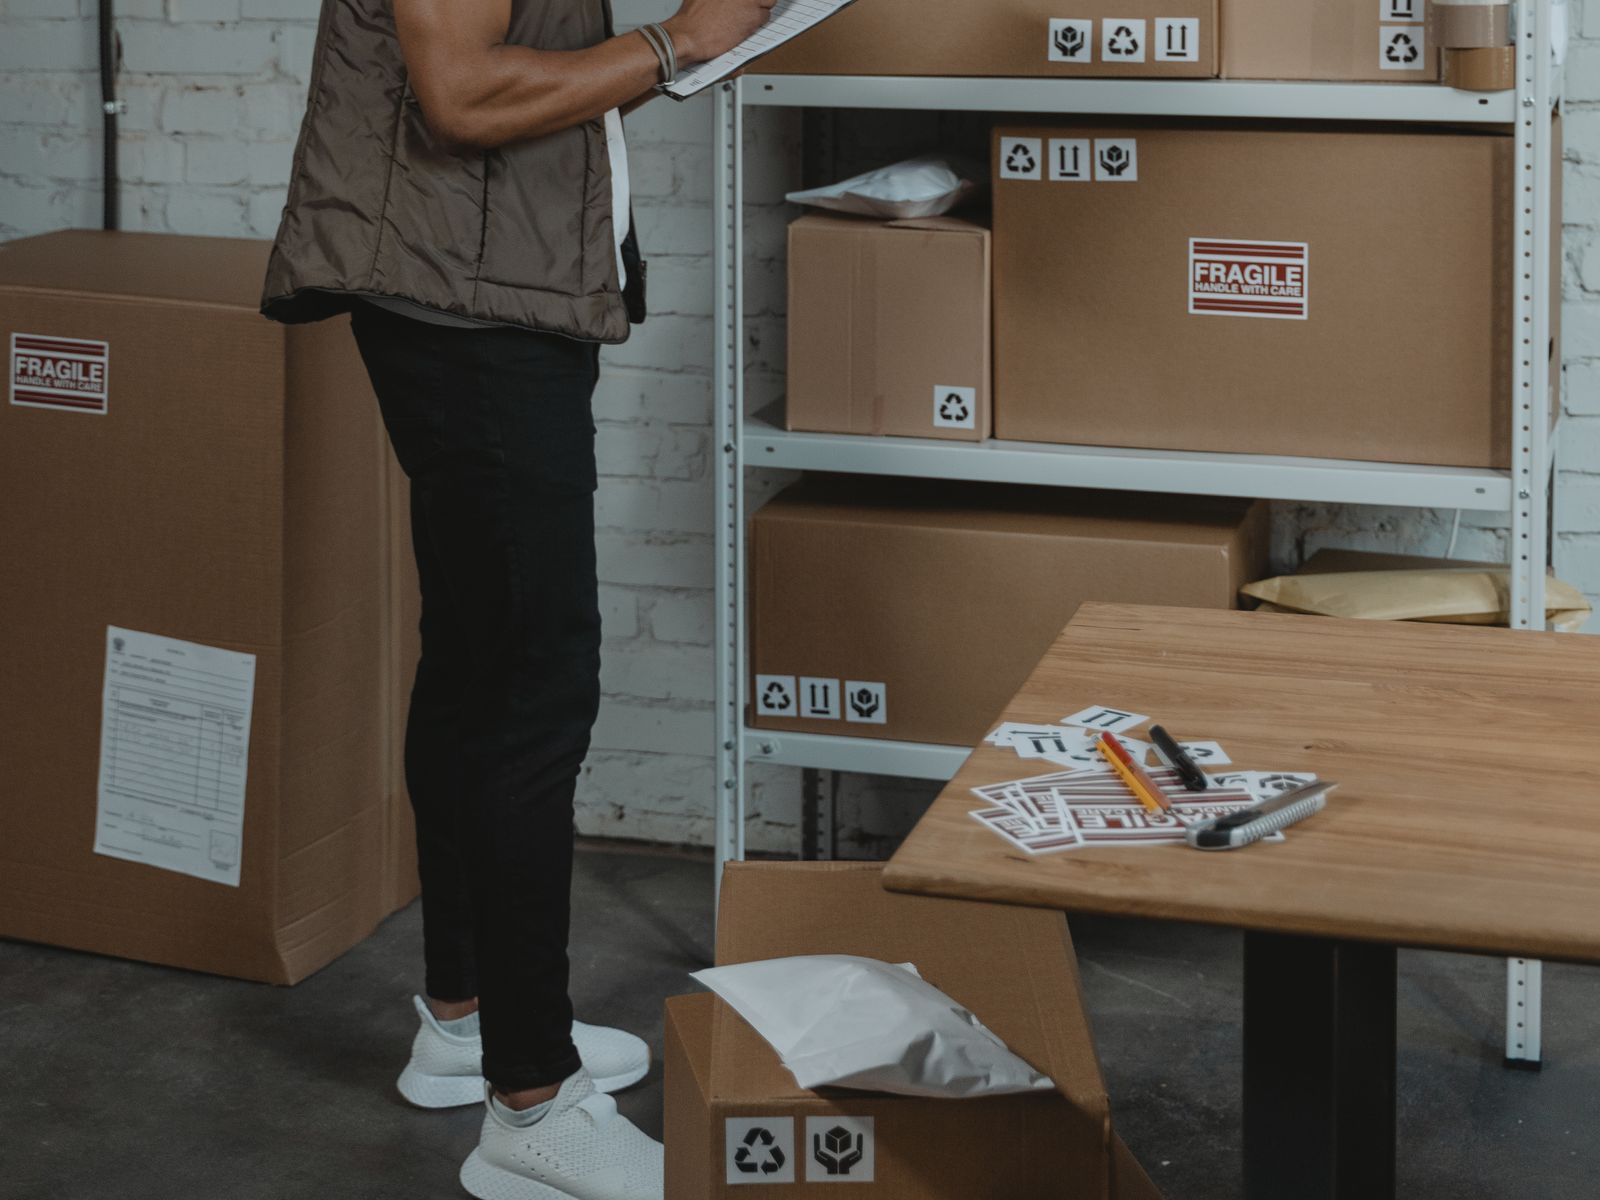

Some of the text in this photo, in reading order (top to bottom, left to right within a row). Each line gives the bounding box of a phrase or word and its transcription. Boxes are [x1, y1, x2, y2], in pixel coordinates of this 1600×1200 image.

[1194, 262, 1302, 287] FRAGILE
[1194, 281, 1302, 297] HANDLE WITH CARE
[16, 355, 104, 383] FRAGILE
[16, 375, 103, 392] HANDLE WITH CARE
